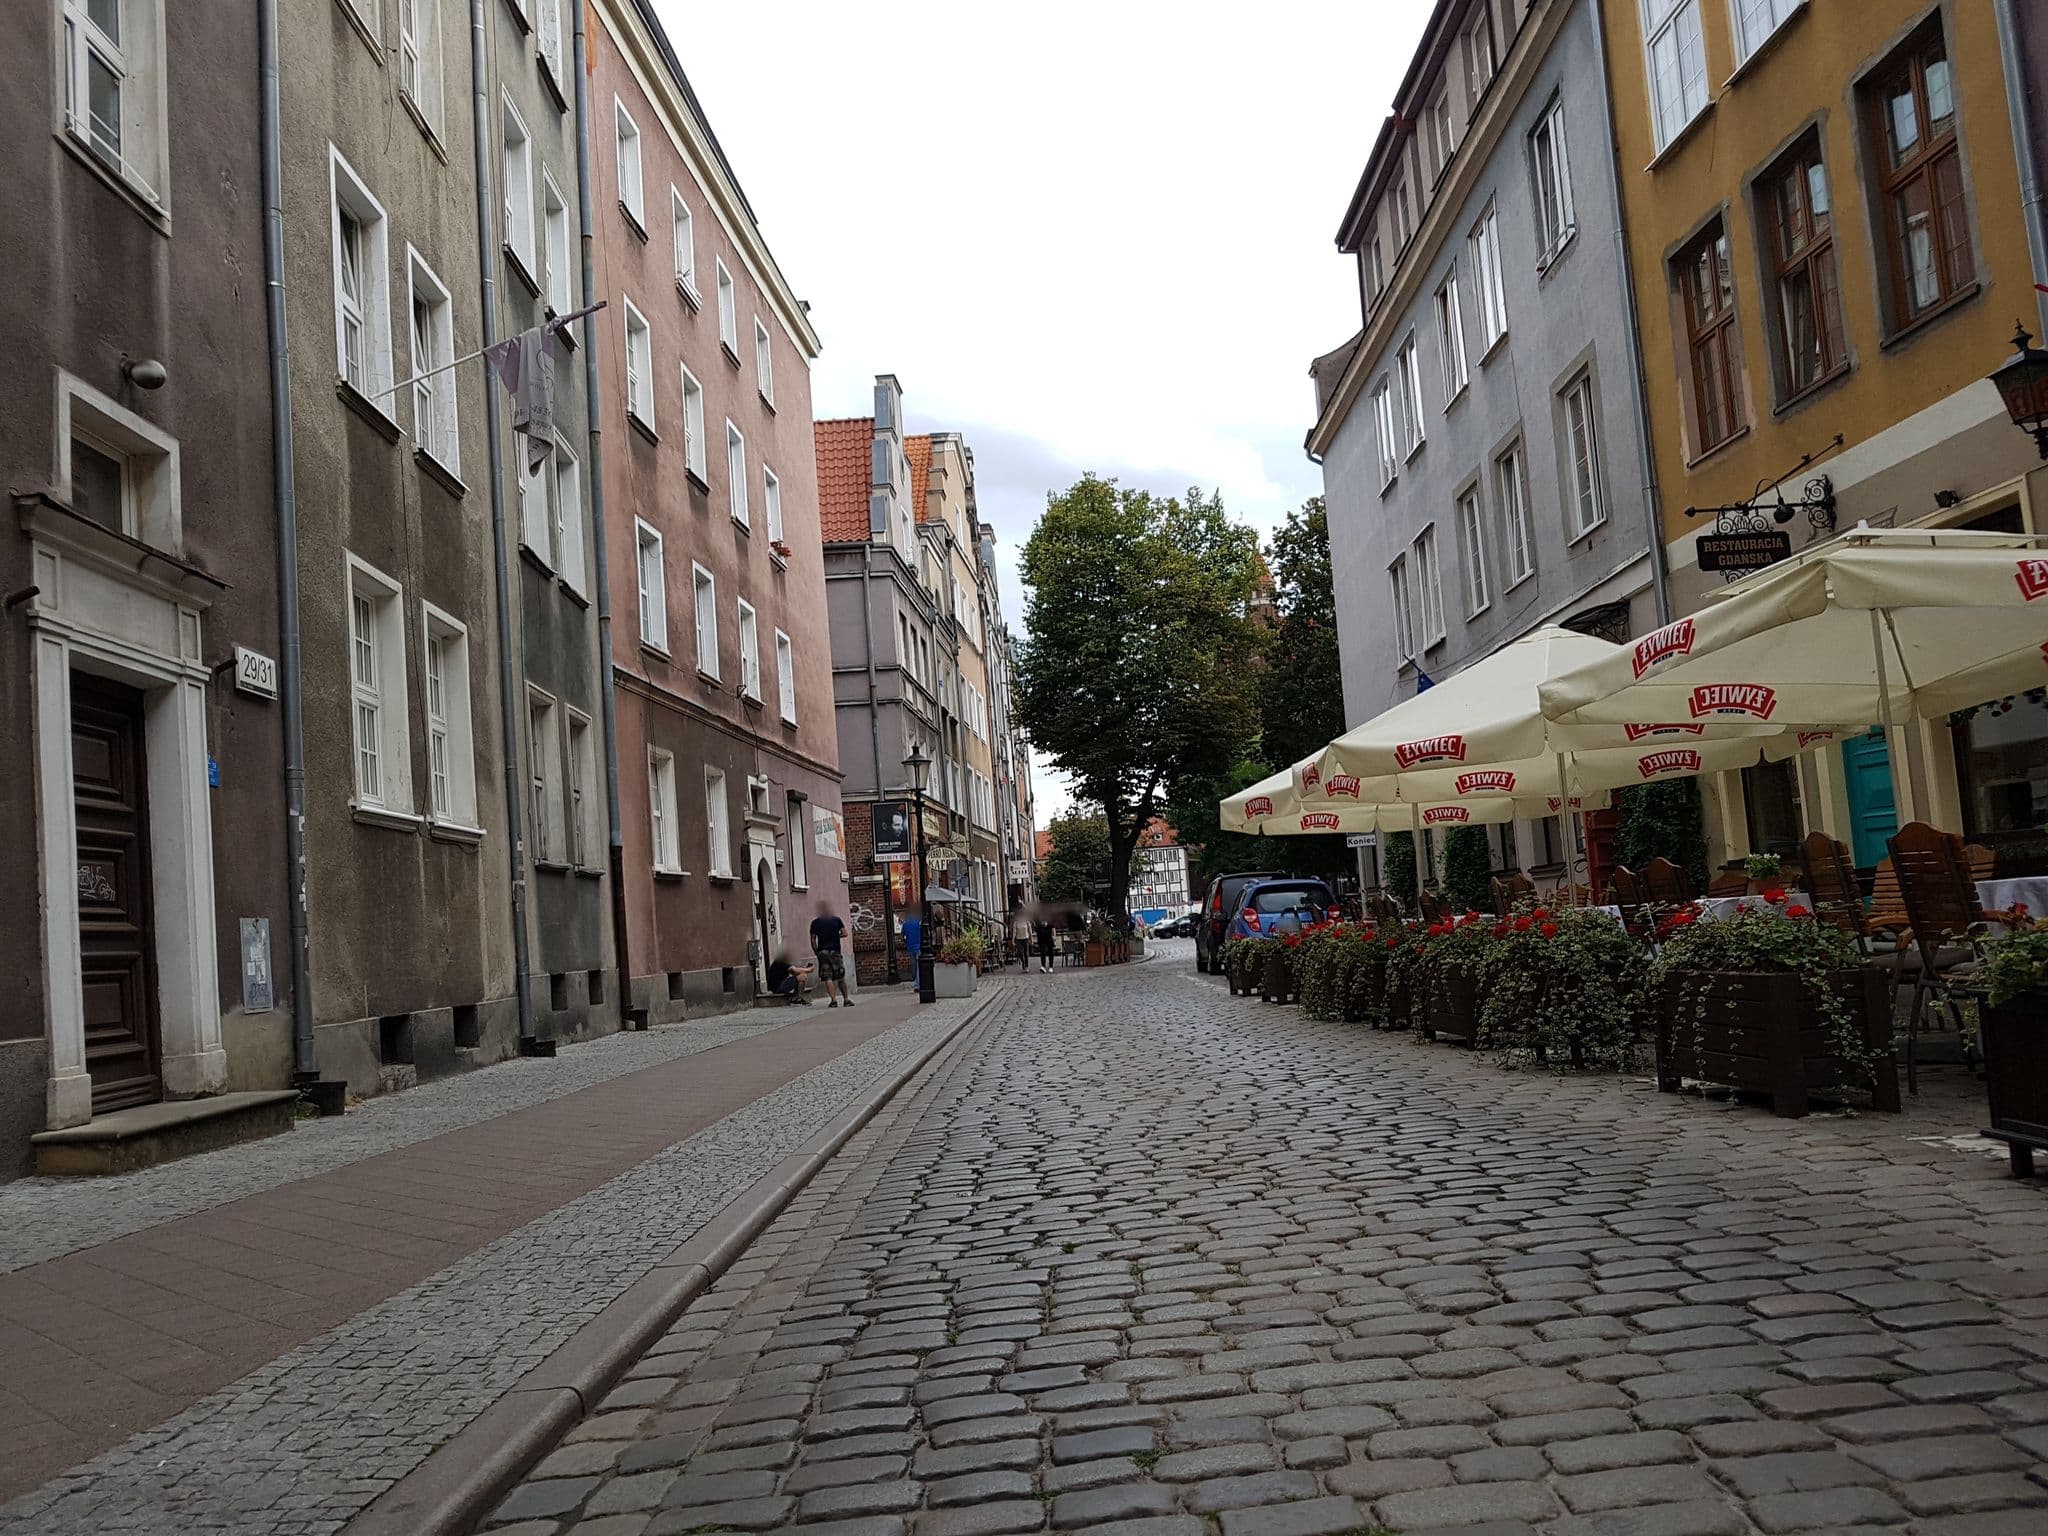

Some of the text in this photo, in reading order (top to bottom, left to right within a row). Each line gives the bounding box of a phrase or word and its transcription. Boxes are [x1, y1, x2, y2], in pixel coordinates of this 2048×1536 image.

[1718, 551, 1773, 566] GDAŃSKA
[1640, 622, 1689, 662] ŻYWIEC
[243, 654, 272, 686] 29/31
[1402, 737, 1457, 760] ŻYWIEC
[1348, 836, 1376, 846] Koniec
